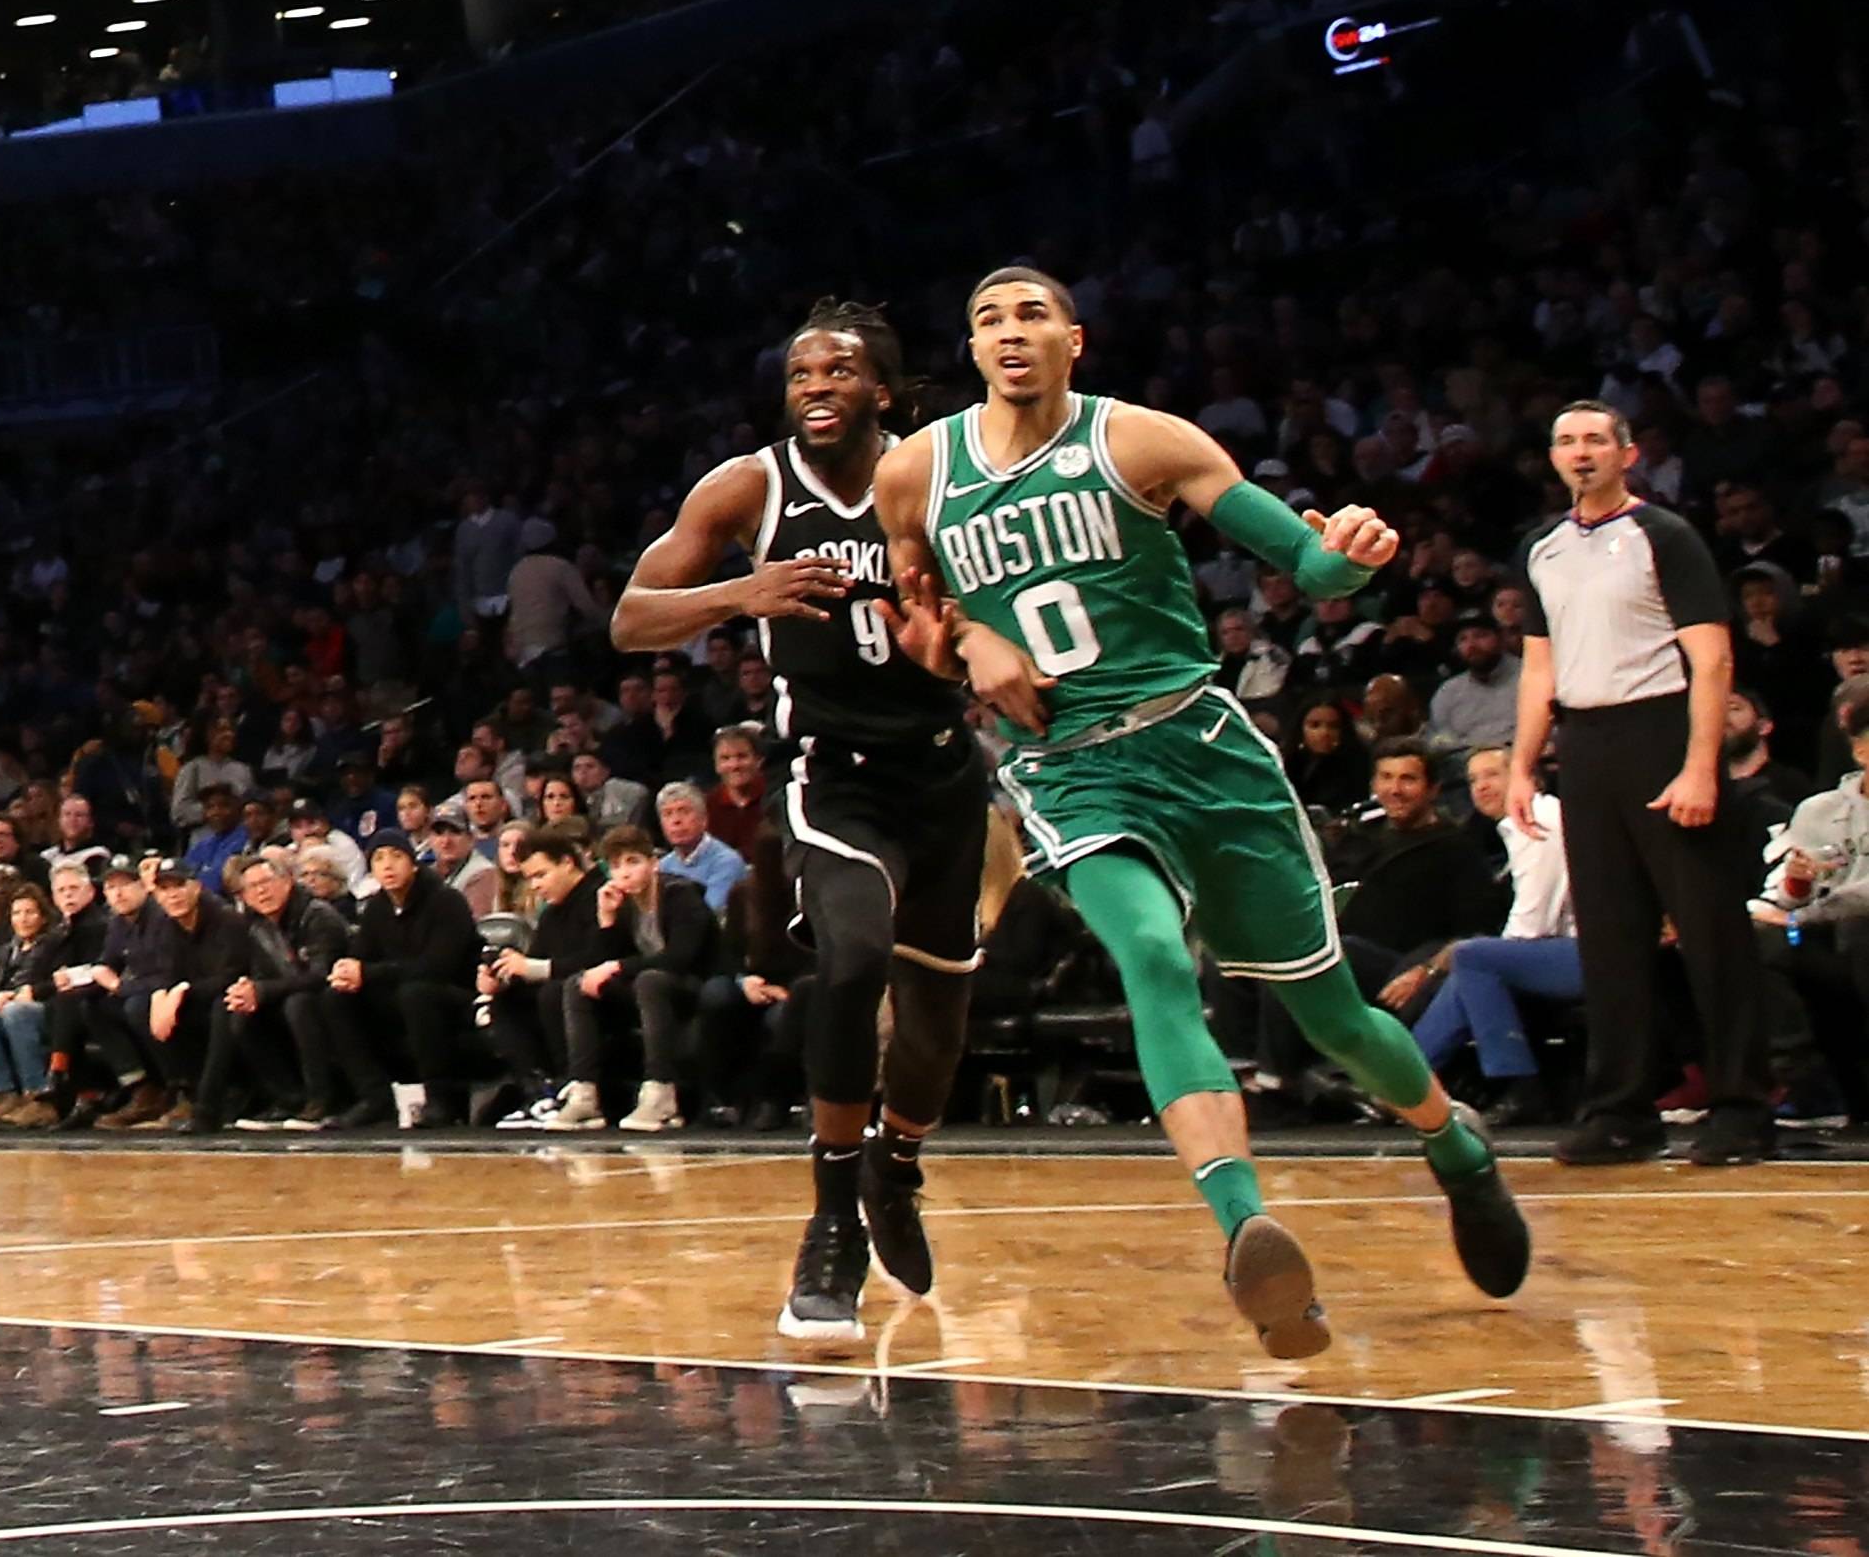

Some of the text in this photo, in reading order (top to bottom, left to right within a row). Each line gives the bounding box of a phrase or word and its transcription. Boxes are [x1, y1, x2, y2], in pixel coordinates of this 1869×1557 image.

[937, 489, 1124, 595] BOSTON
[851, 599, 891, 666] 9
[1012, 580, 1103, 678] 0
